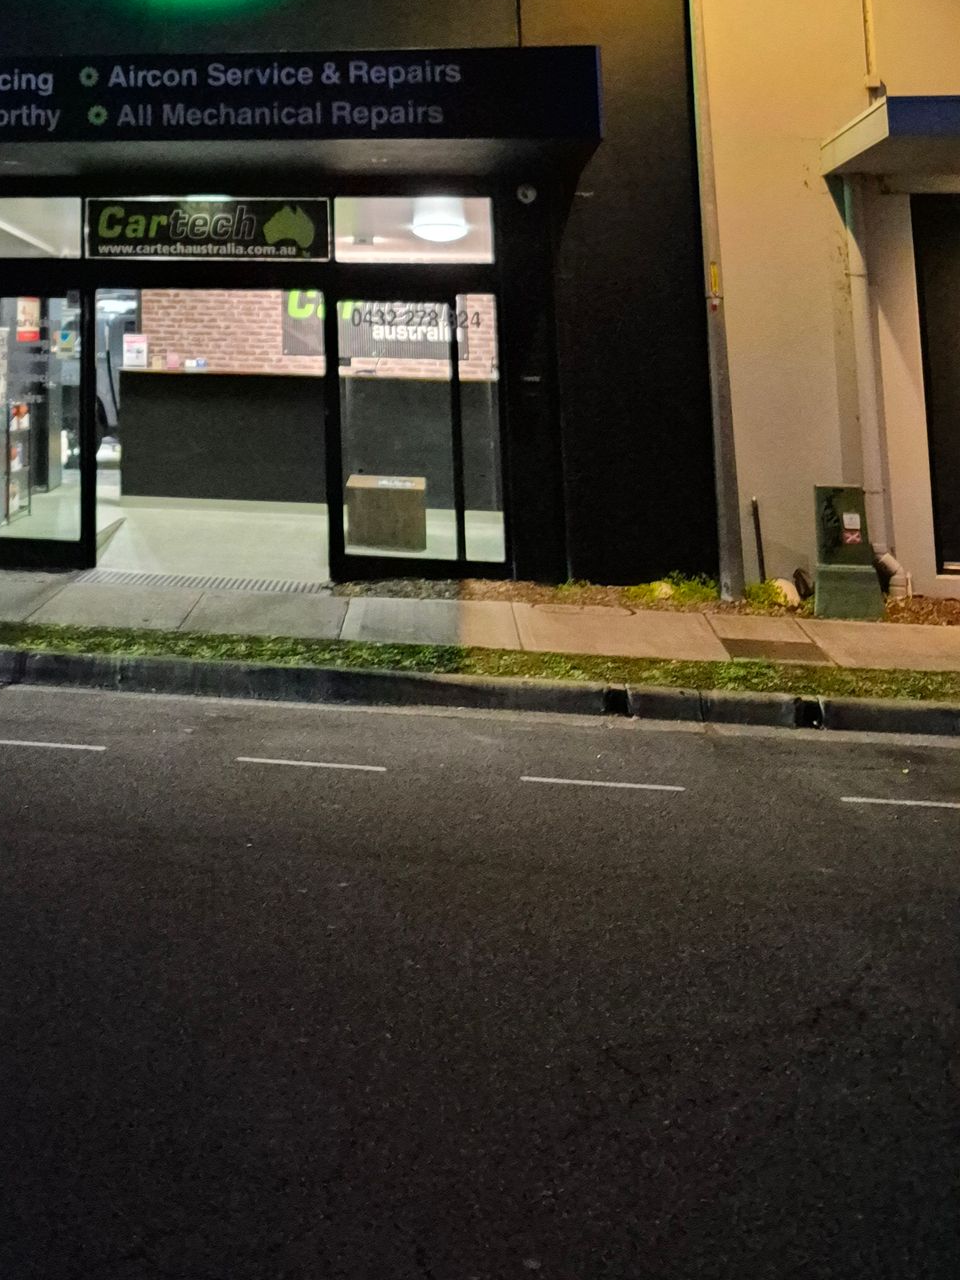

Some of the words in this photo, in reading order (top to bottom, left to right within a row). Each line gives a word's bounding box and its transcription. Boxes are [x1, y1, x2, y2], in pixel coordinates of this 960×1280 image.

[108, 65, 197, 87] Aircon
[207, 61, 314, 86] Service
[321, 62, 340, 84] &
[349, 60, 461, 88] Repairs
[117, 104, 151, 126] All
[162, 101, 322, 125] Mechanical
[331, 100, 443, 129] Repairs
[98, 242, 297, 256] www.cartechaustralia.com.au
[352, 309, 397, 327] 0432
[405, 310, 438, 327] 278
